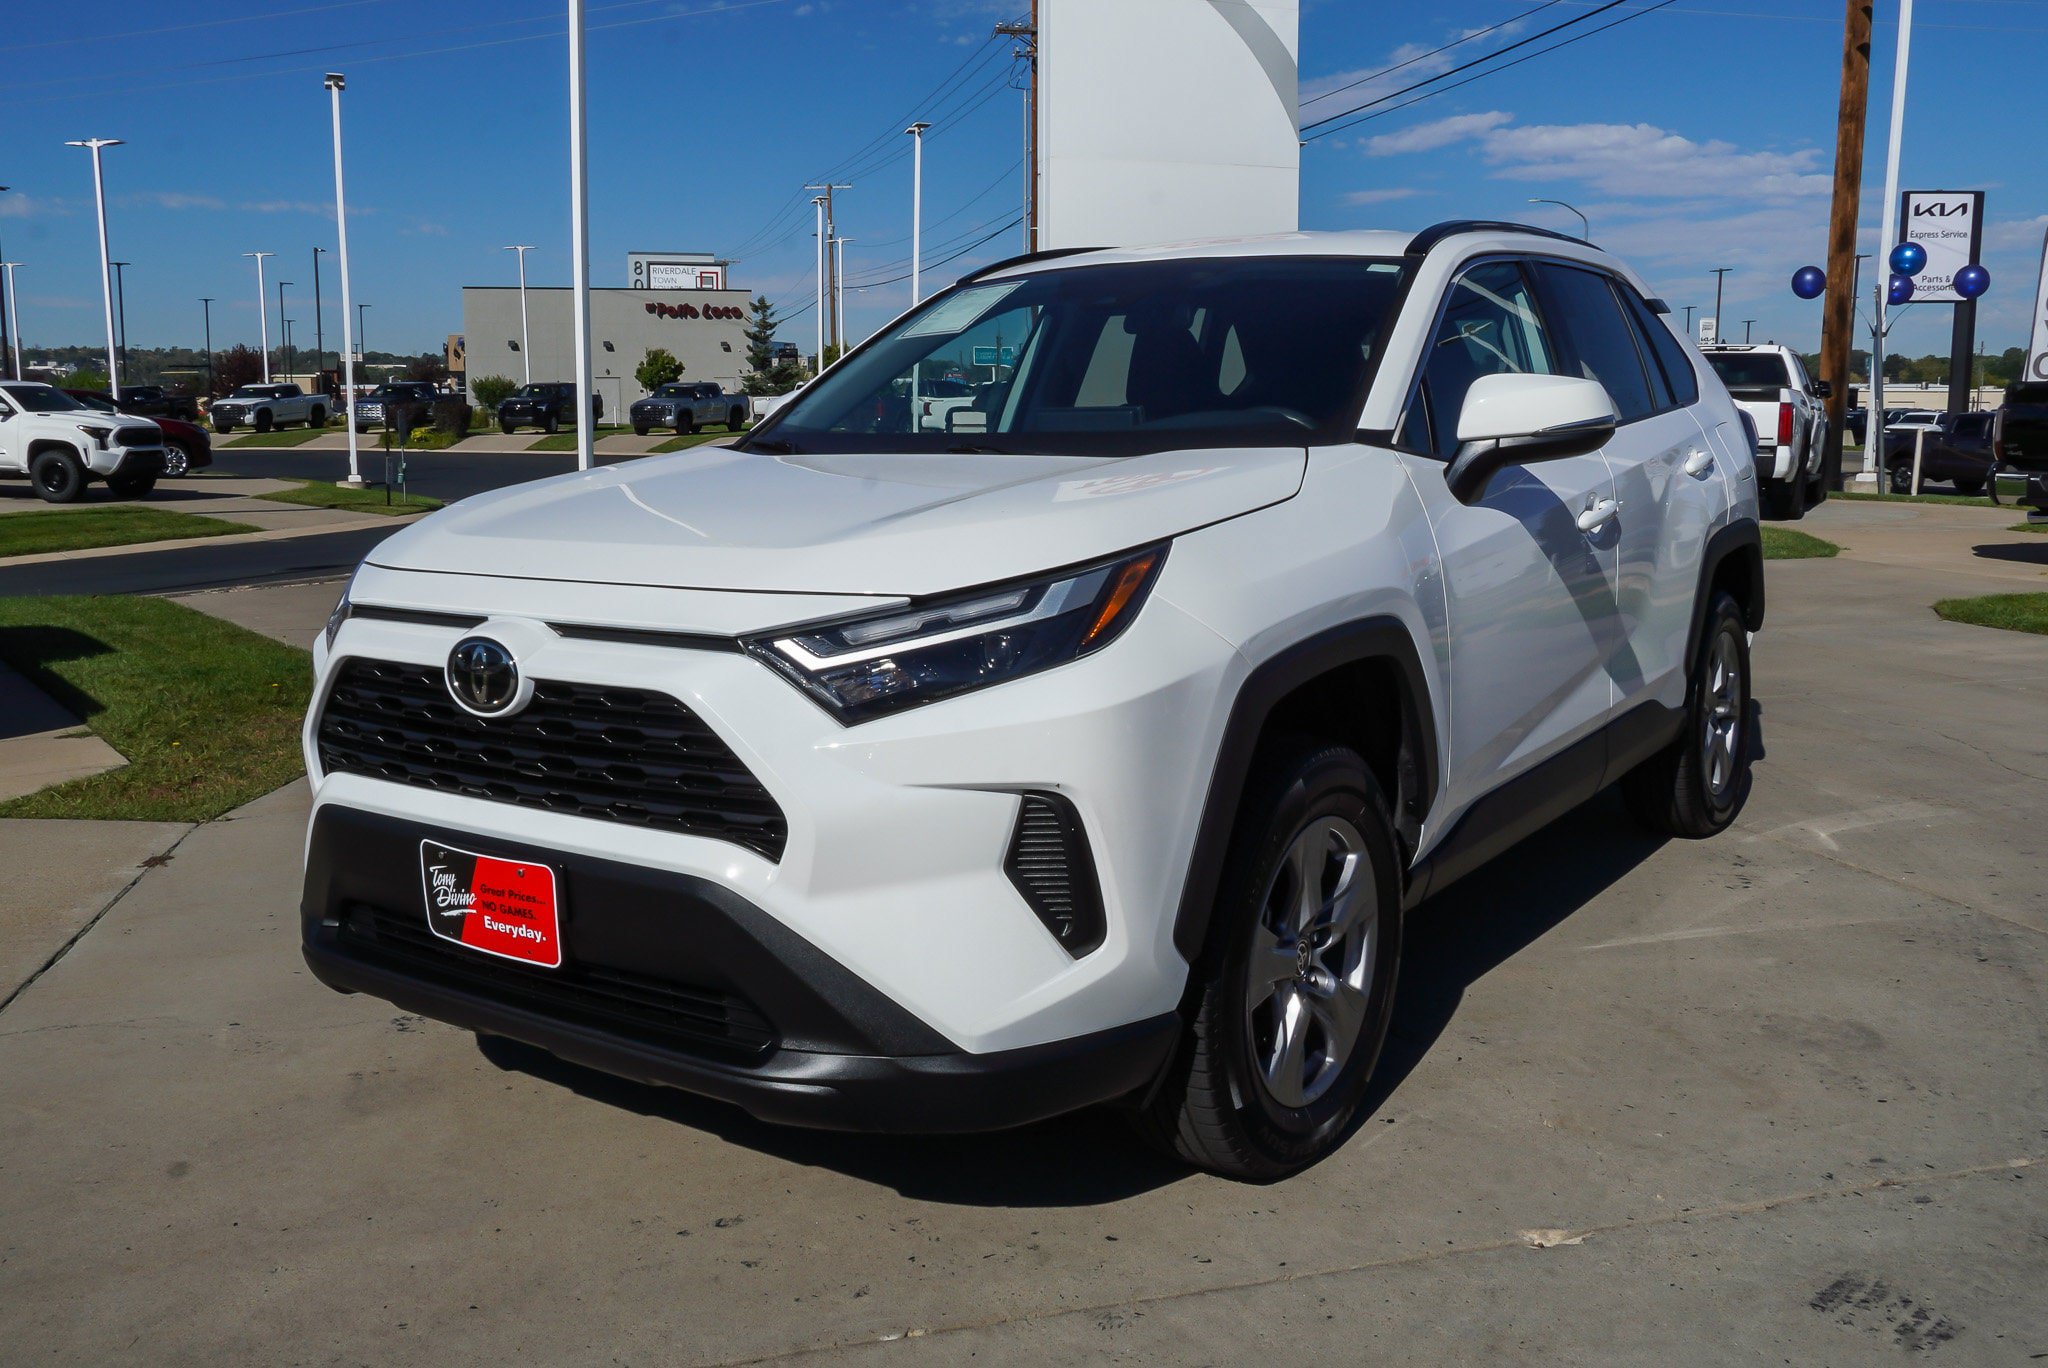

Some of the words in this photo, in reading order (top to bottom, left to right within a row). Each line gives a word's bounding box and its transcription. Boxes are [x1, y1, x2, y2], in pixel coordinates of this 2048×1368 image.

[1910, 230, 1939, 239] Express
[1941, 230, 1968, 238] Service
[652, 267, 696, 275] RIVERDALE
[1945, 275, 1951, 283] &
[702, 303, 743, 319] Loco
[429, 865, 457, 891] Tony
[433, 886, 477, 907] Divino
[480, 883, 505, 897] Great
[482, 900, 497, 913] NO
[499, 903, 537, 920] GAMES.
[484, 915, 547, 943] Everyday.
